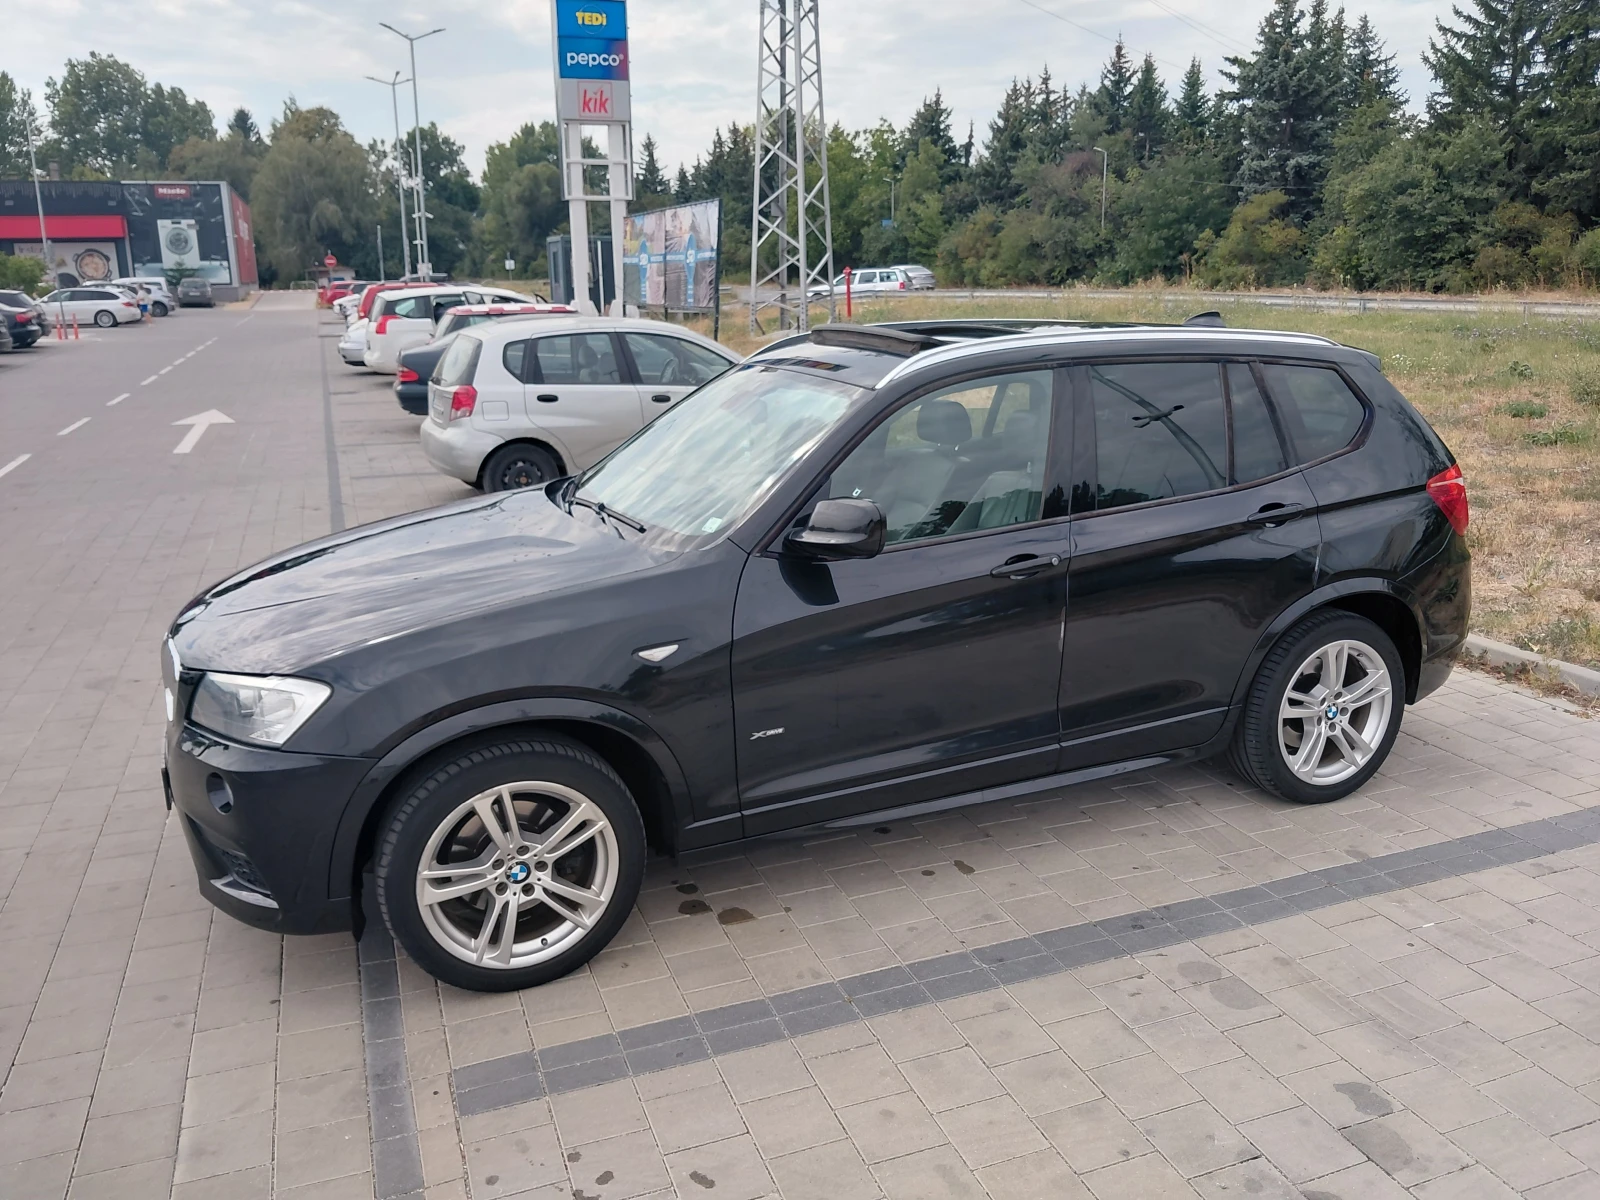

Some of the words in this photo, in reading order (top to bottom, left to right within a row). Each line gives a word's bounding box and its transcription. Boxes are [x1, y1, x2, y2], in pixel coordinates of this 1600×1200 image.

[576, 12, 607, 26] TEDi
[567, 52, 620, 67] pepco
[158, 187, 186, 195] Miele
